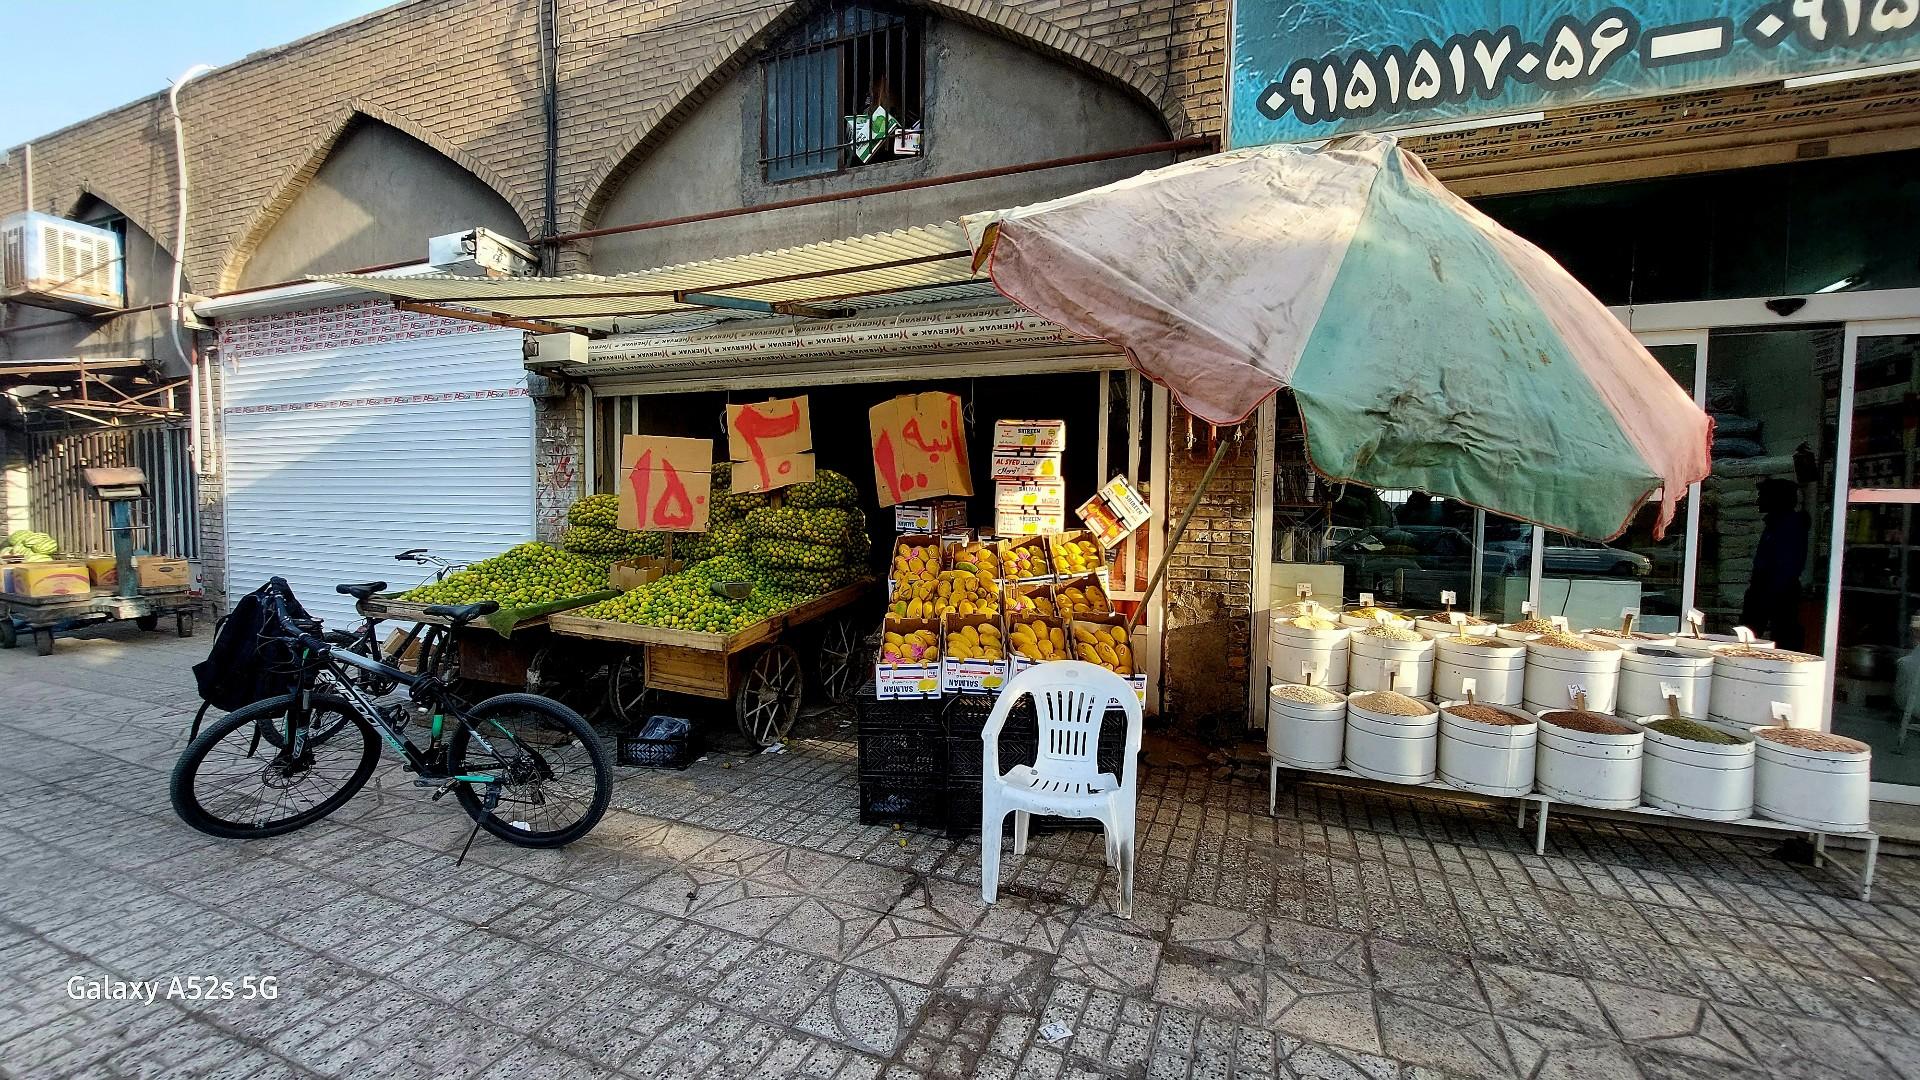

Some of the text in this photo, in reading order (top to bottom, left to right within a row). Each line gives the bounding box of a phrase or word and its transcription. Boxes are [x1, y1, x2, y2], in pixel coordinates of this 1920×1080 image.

[1265, 17, 1629, 115] ۰۹۱۵۱۵۱۷۰۵۶
[318, 669, 380, 728] RAPIDO
[883, 685, 914, 693] SALMAN
[949, 679, 979, 687] SALMAN
